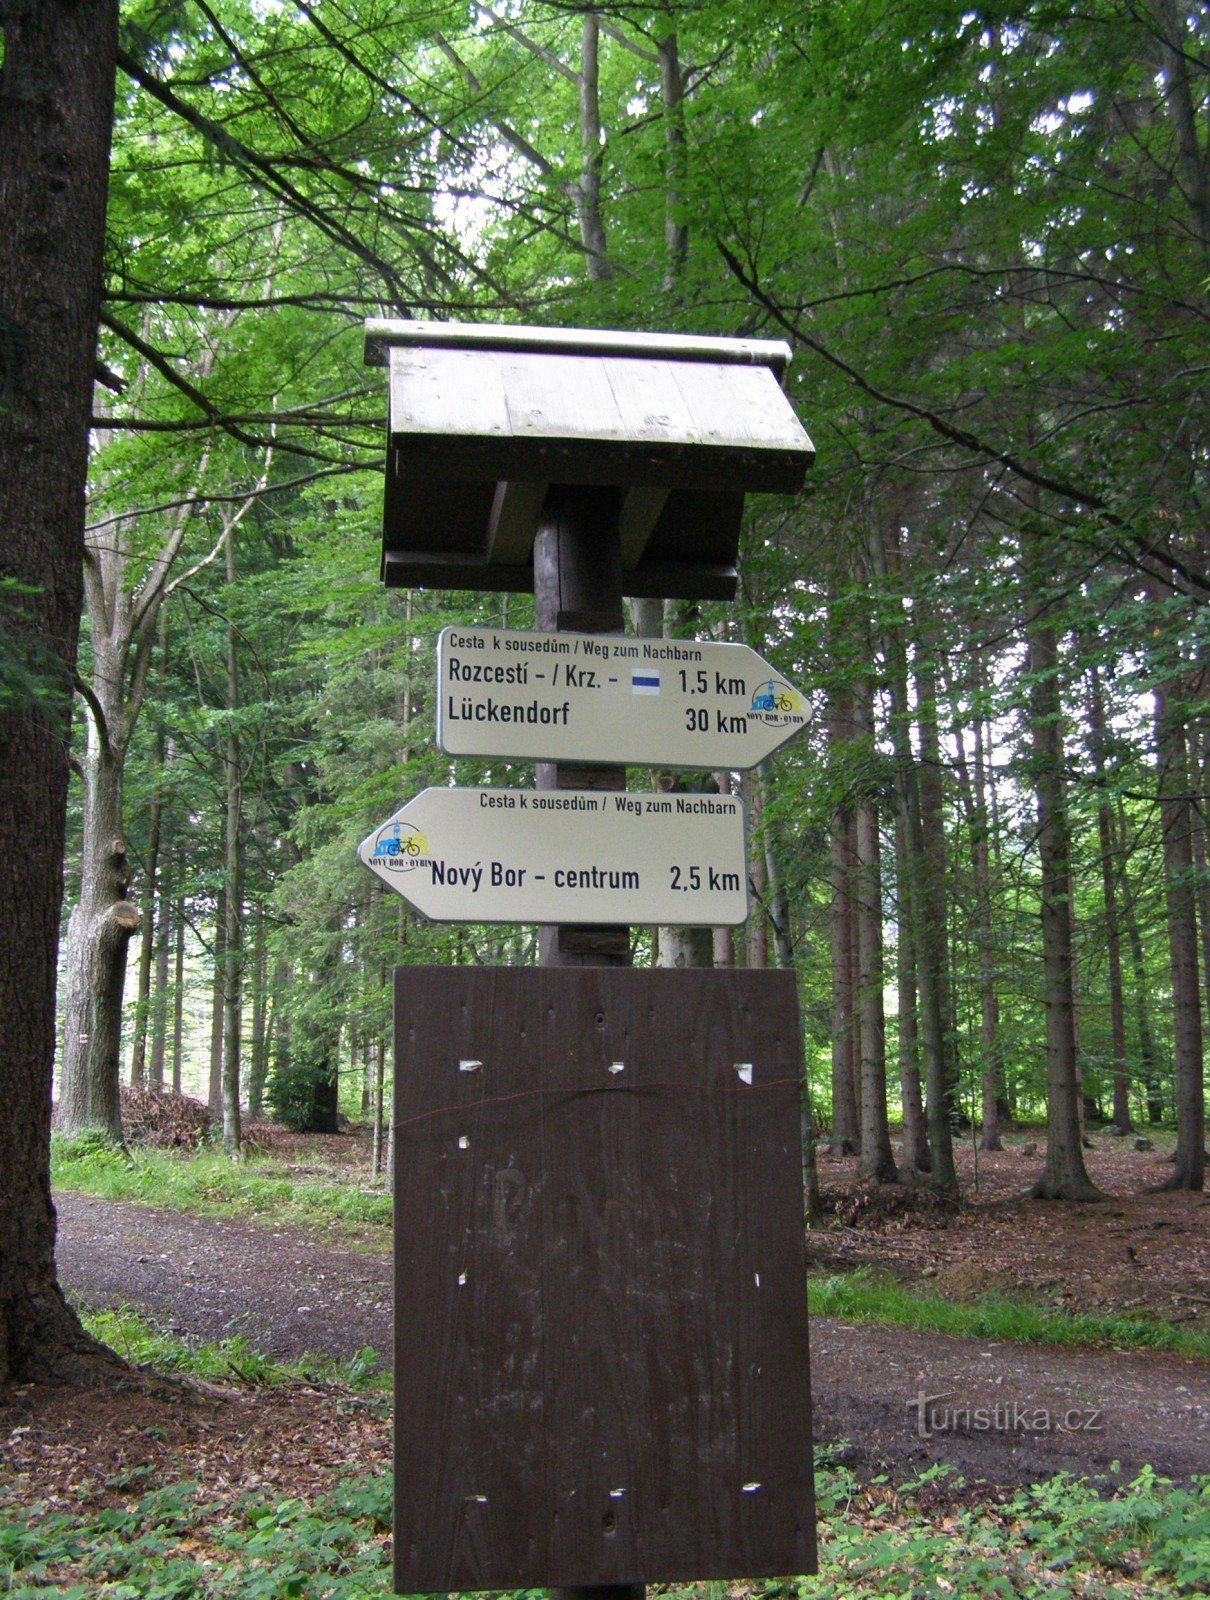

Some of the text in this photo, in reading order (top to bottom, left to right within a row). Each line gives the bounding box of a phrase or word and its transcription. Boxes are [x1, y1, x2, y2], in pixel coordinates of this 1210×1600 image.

[450, 633, 485, 649] Cesta
[493, 636, 501, 650] k
[505, 639, 570, 654] sousedům
[583, 641, 609, 659] Weg
[613, 646, 639, 658] zum
[643, 645, 702, 661] Nachbarn
[449, 658, 529, 684] Rozcestí
[566, 665, 601, 688] Krz.
[679, 670, 708, 695] 1,5
[716, 672, 746, 696] km
[449, 696, 747, 734] Lückendorf 30 km
[480, 793, 516, 809] Cesta
[520, 794, 528, 809] k
[532, 796, 598, 811] sousedům
[615, 797, 642, 816] Weg
[646, 802, 672, 813] zum
[676, 799, 736, 815] Nachbarn
[389, 858, 404, 867] BOR
[432, 861, 483, 893] Nový
[491, 862, 527, 887] Bor
[554, 866, 640, 889] centrum
[670, 866, 701, 892] 2,5
[708, 867, 740, 891] km
